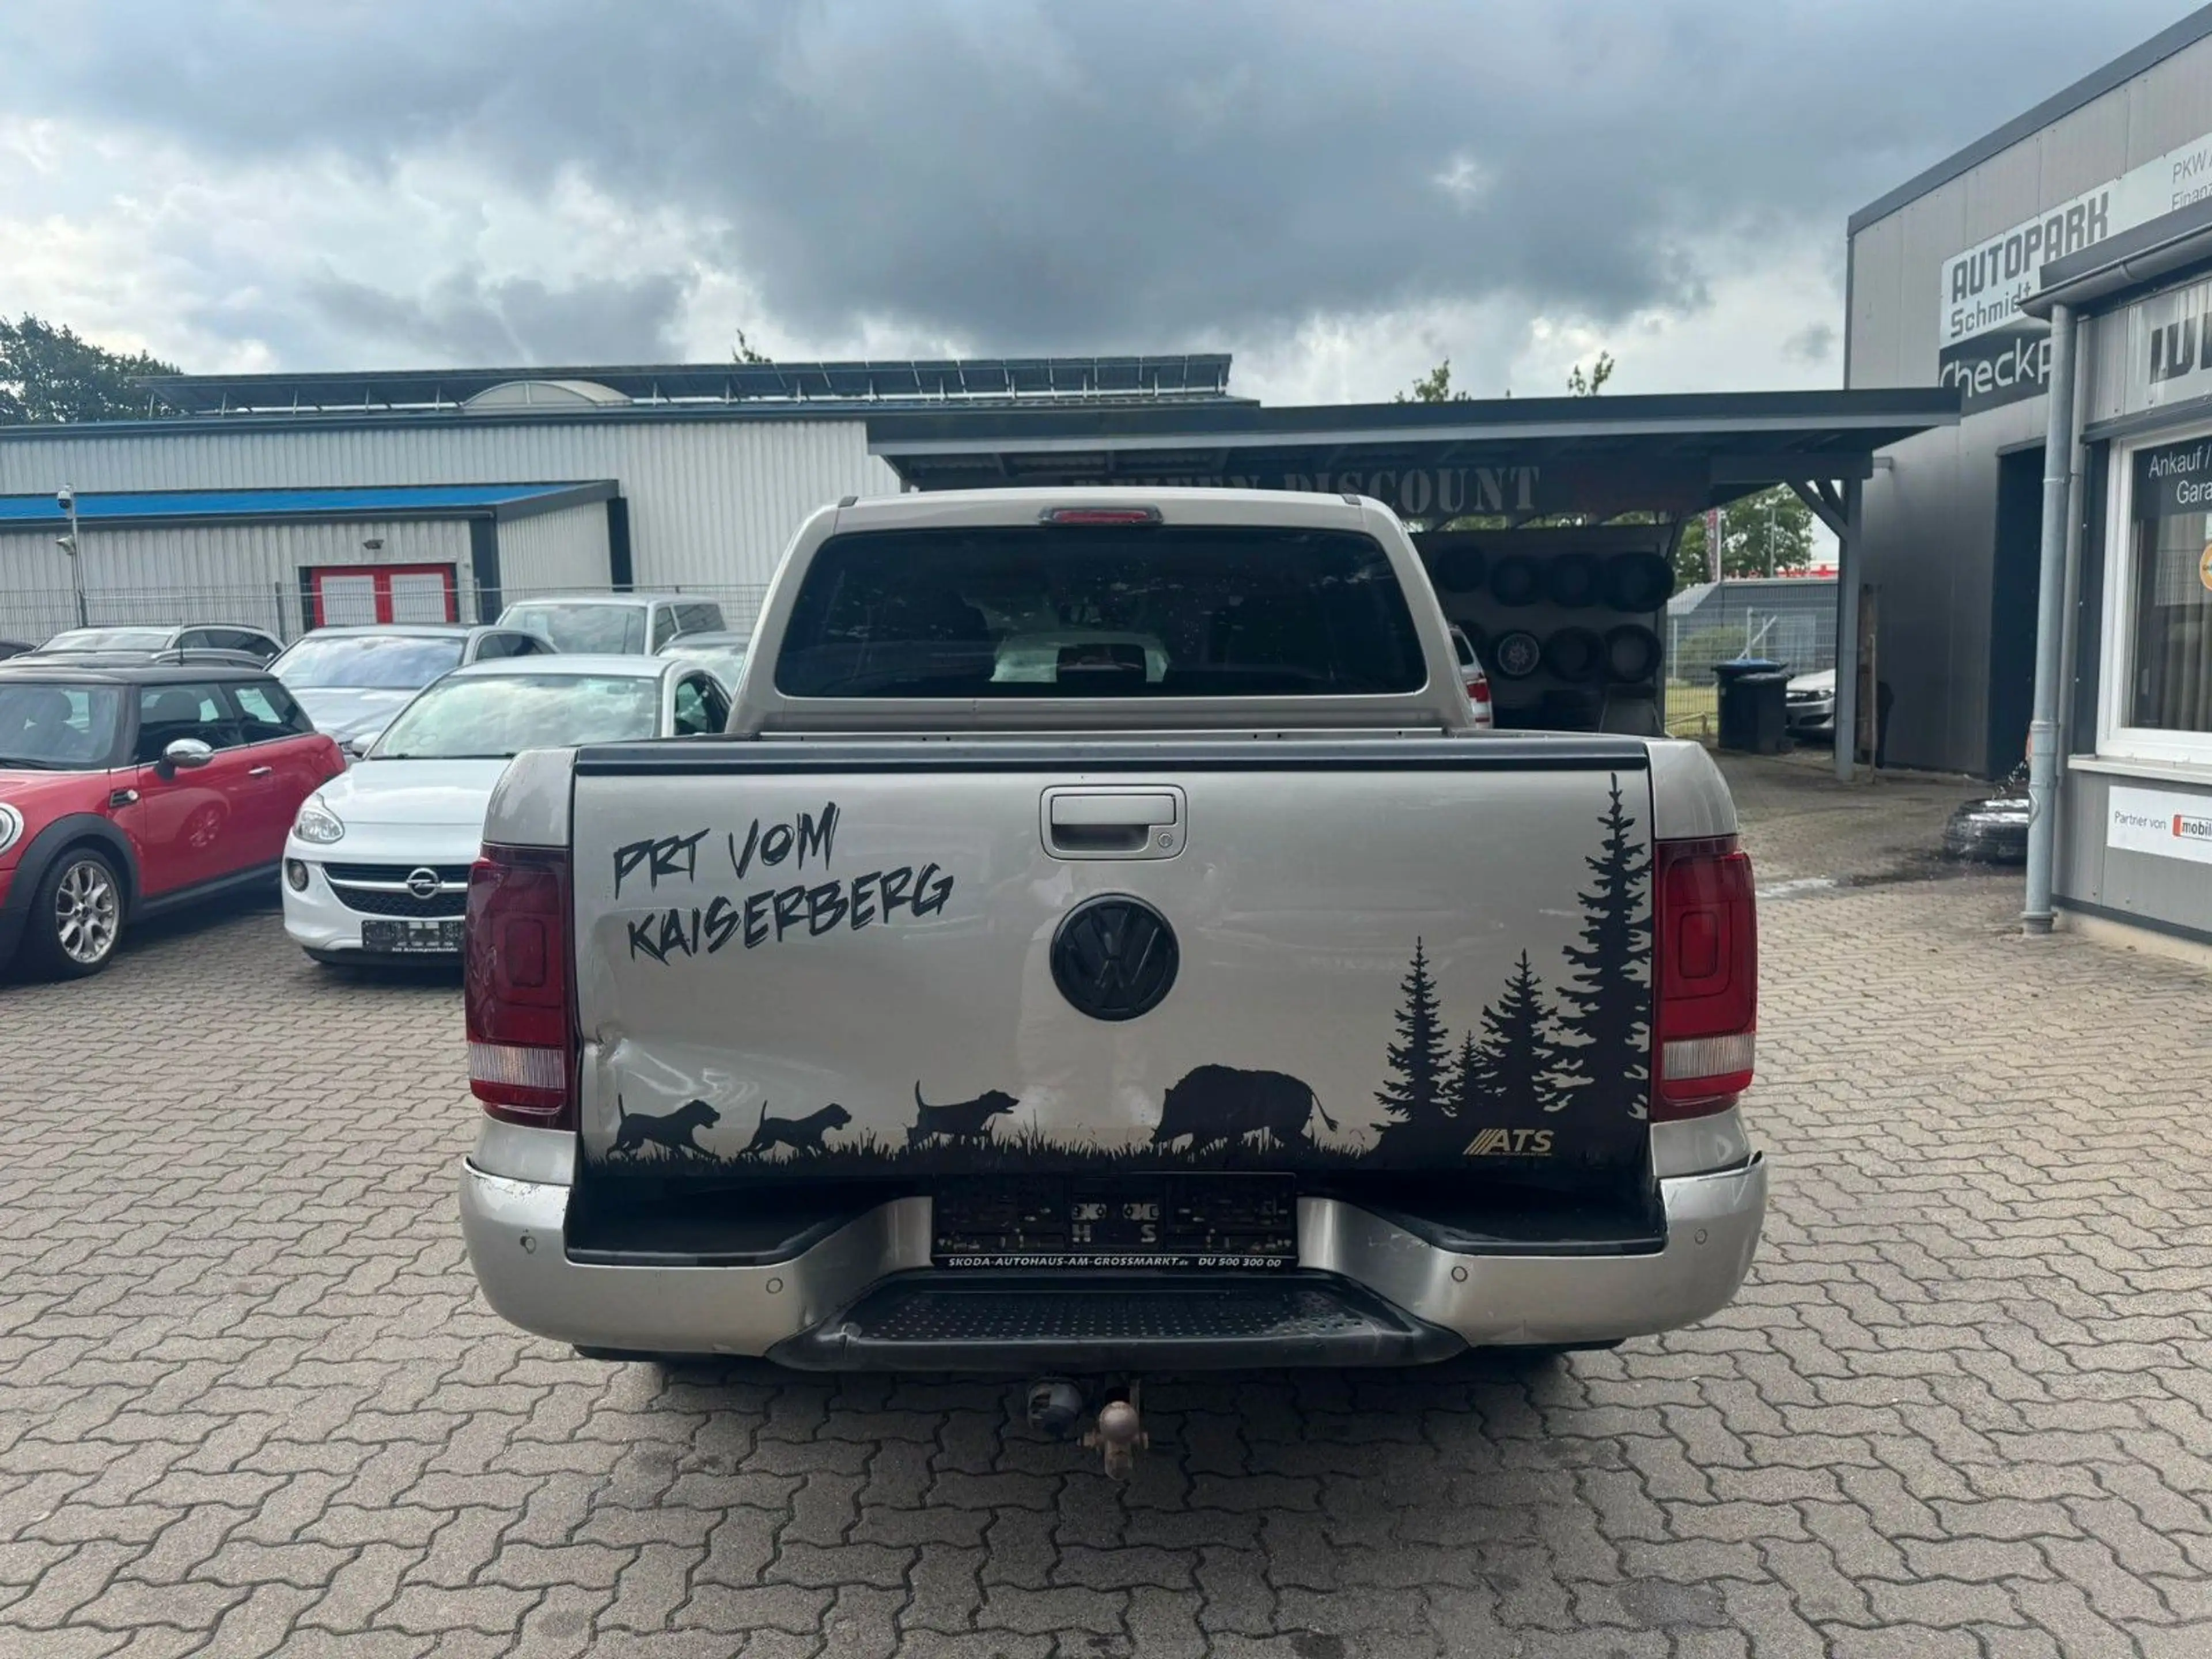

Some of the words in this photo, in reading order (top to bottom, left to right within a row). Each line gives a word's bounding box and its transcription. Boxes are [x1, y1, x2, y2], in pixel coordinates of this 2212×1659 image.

[2172, 149, 2206, 184] PKW
[1952, 191, 2109, 305] AUTOPARK
[1950, 281, 2031, 338] Schmidt
[2148, 445, 2203, 478] Ankauf
[2114, 810, 2147, 828] Partner
[2149, 818, 2166, 830] von
[613, 828, 711, 900] PRT
[728, 801, 840, 879] VOM
[627, 862, 953, 966] KAISERBERG
[1478, 1128, 1555, 1155] ATS
[1198, 1257, 1216, 1266] DU
[1218, 1257, 1240, 1266] 500
[1242, 1257, 1264, 1267] 300
[1267, 1258, 1282, 1267] 00
